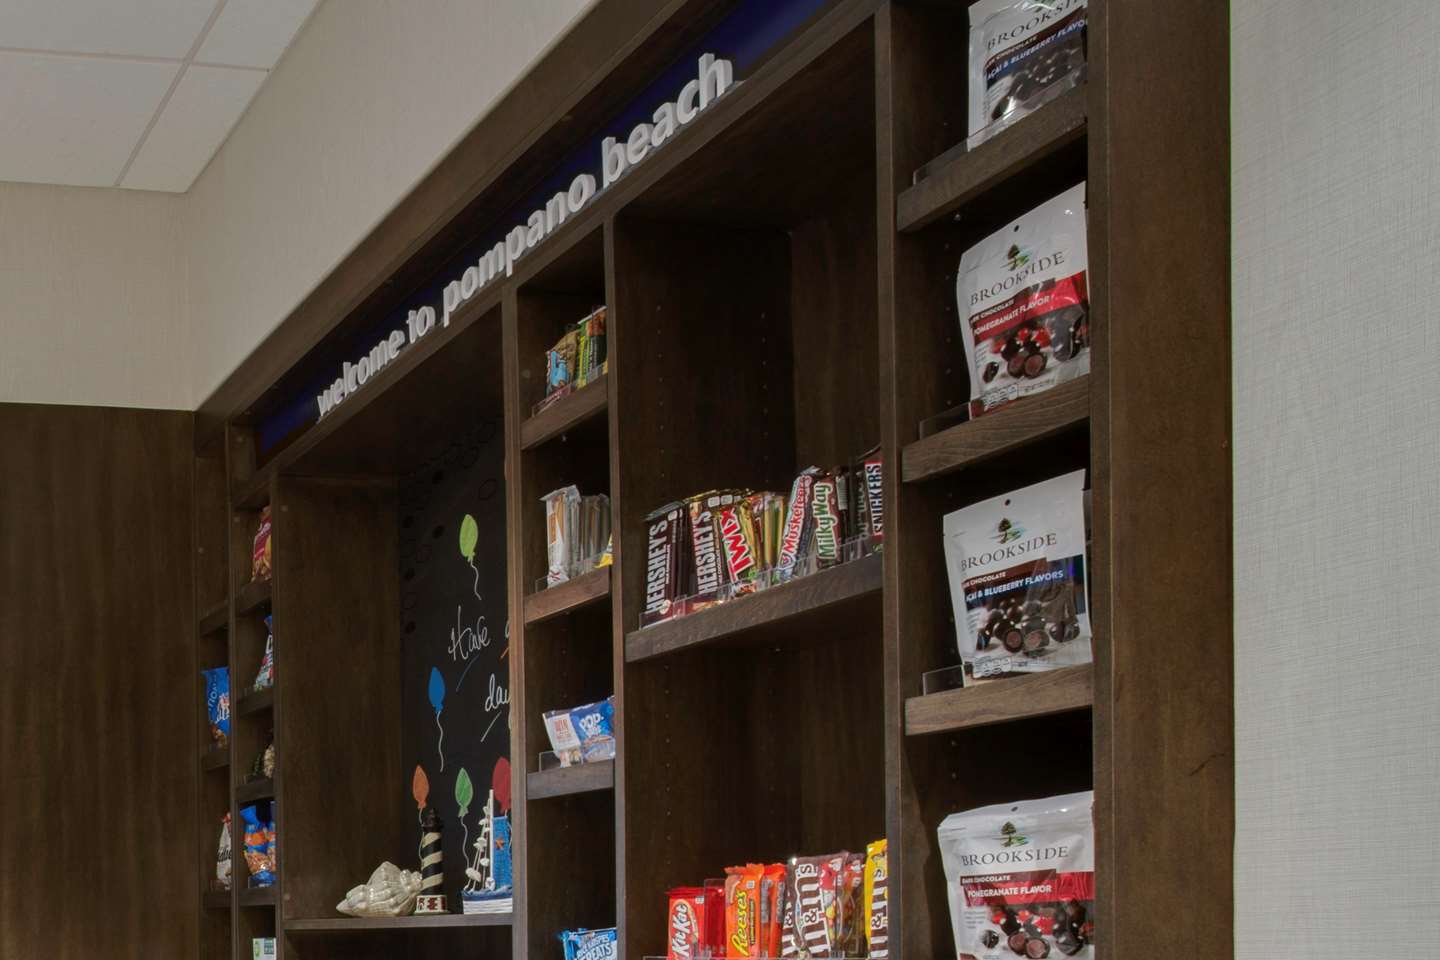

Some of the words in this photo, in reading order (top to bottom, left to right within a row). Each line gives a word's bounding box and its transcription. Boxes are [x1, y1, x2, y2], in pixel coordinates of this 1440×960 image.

[316, 330, 405, 417] welcome
[406, 306, 436, 347] to
[442, 173, 596, 328] pompano
[601, 52, 733, 189] beach
[969, 251, 1066, 306] BROOKSIDE
[865, 463, 883, 535] SNICKERS
[645, 518, 669, 615] HERSHEY'S
[694, 510, 718, 595] HERSHEY'S
[960, 533, 1058, 571] BROOKSIDE
[984, 580, 1024, 597] BLUEBERRY
[1025, 570, 1065, 585] FLAVORS
[448, 605, 491, 661] Have
[961, 846, 1070, 867] BROOKSIDE
[974, 875, 1011, 884] CHOCOLATE
[967, 887, 1019, 898] POMEGRANATE
[1020, 884, 1052, 895] FLAVOR
